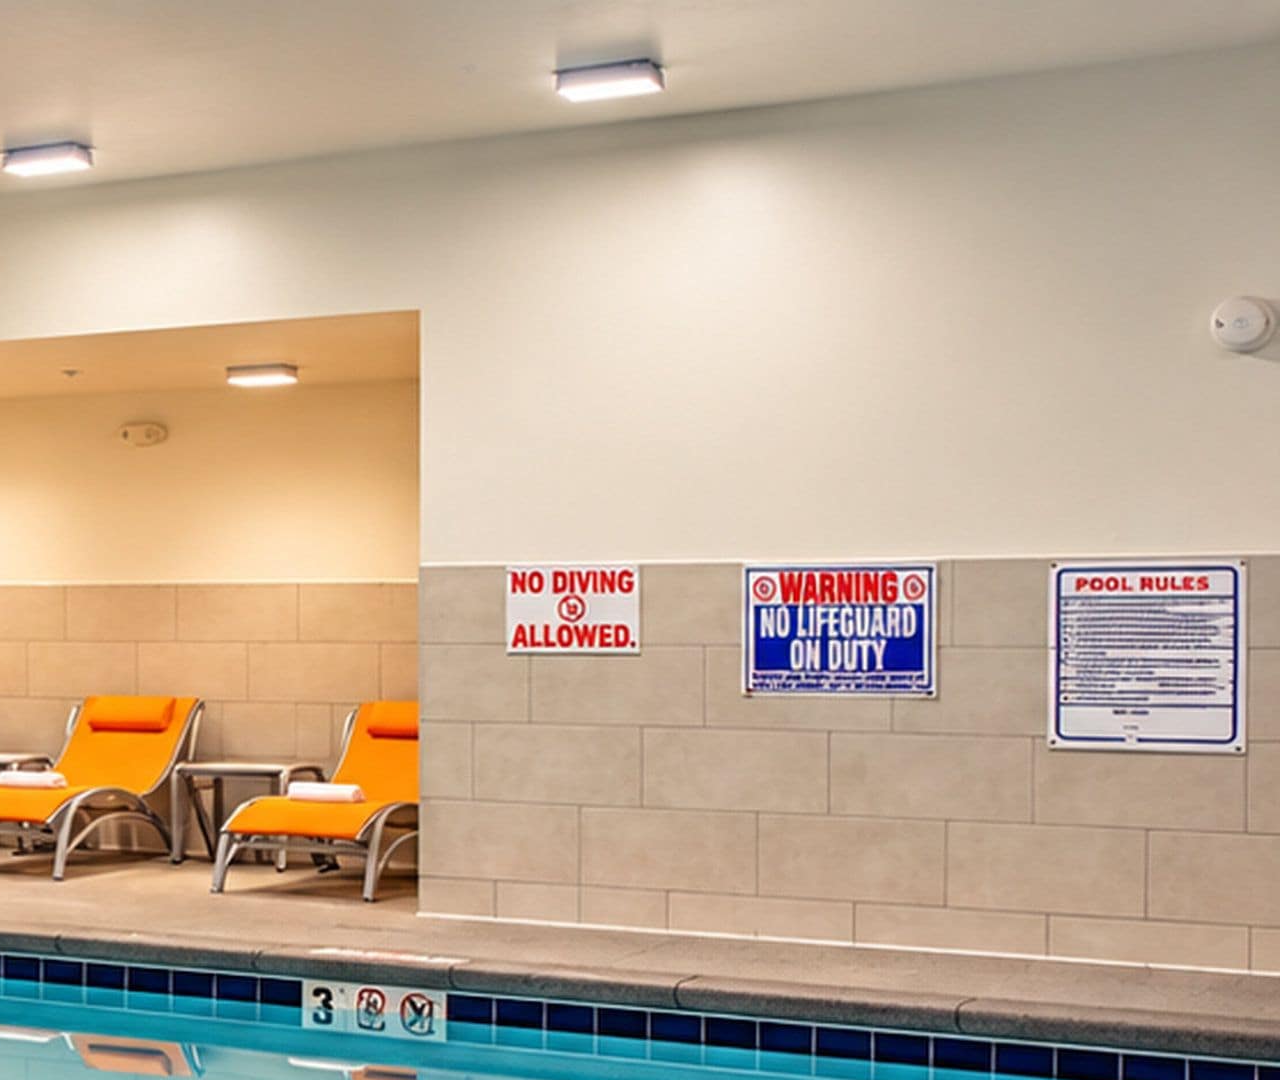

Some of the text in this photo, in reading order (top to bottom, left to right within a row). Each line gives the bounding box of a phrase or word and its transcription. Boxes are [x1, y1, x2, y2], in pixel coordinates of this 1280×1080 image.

[511, 570, 634, 593] NO DIVING
[779, 571, 898, 604] WARNING
[1075, 576, 1209, 591] POOL RULES
[511, 624, 636, 648] ALLOWED.
[760, 607, 917, 638] NO LIFEGUARD
[790, 639, 887, 671] ON DUTY
[312, 987, 334, 1024] 3
